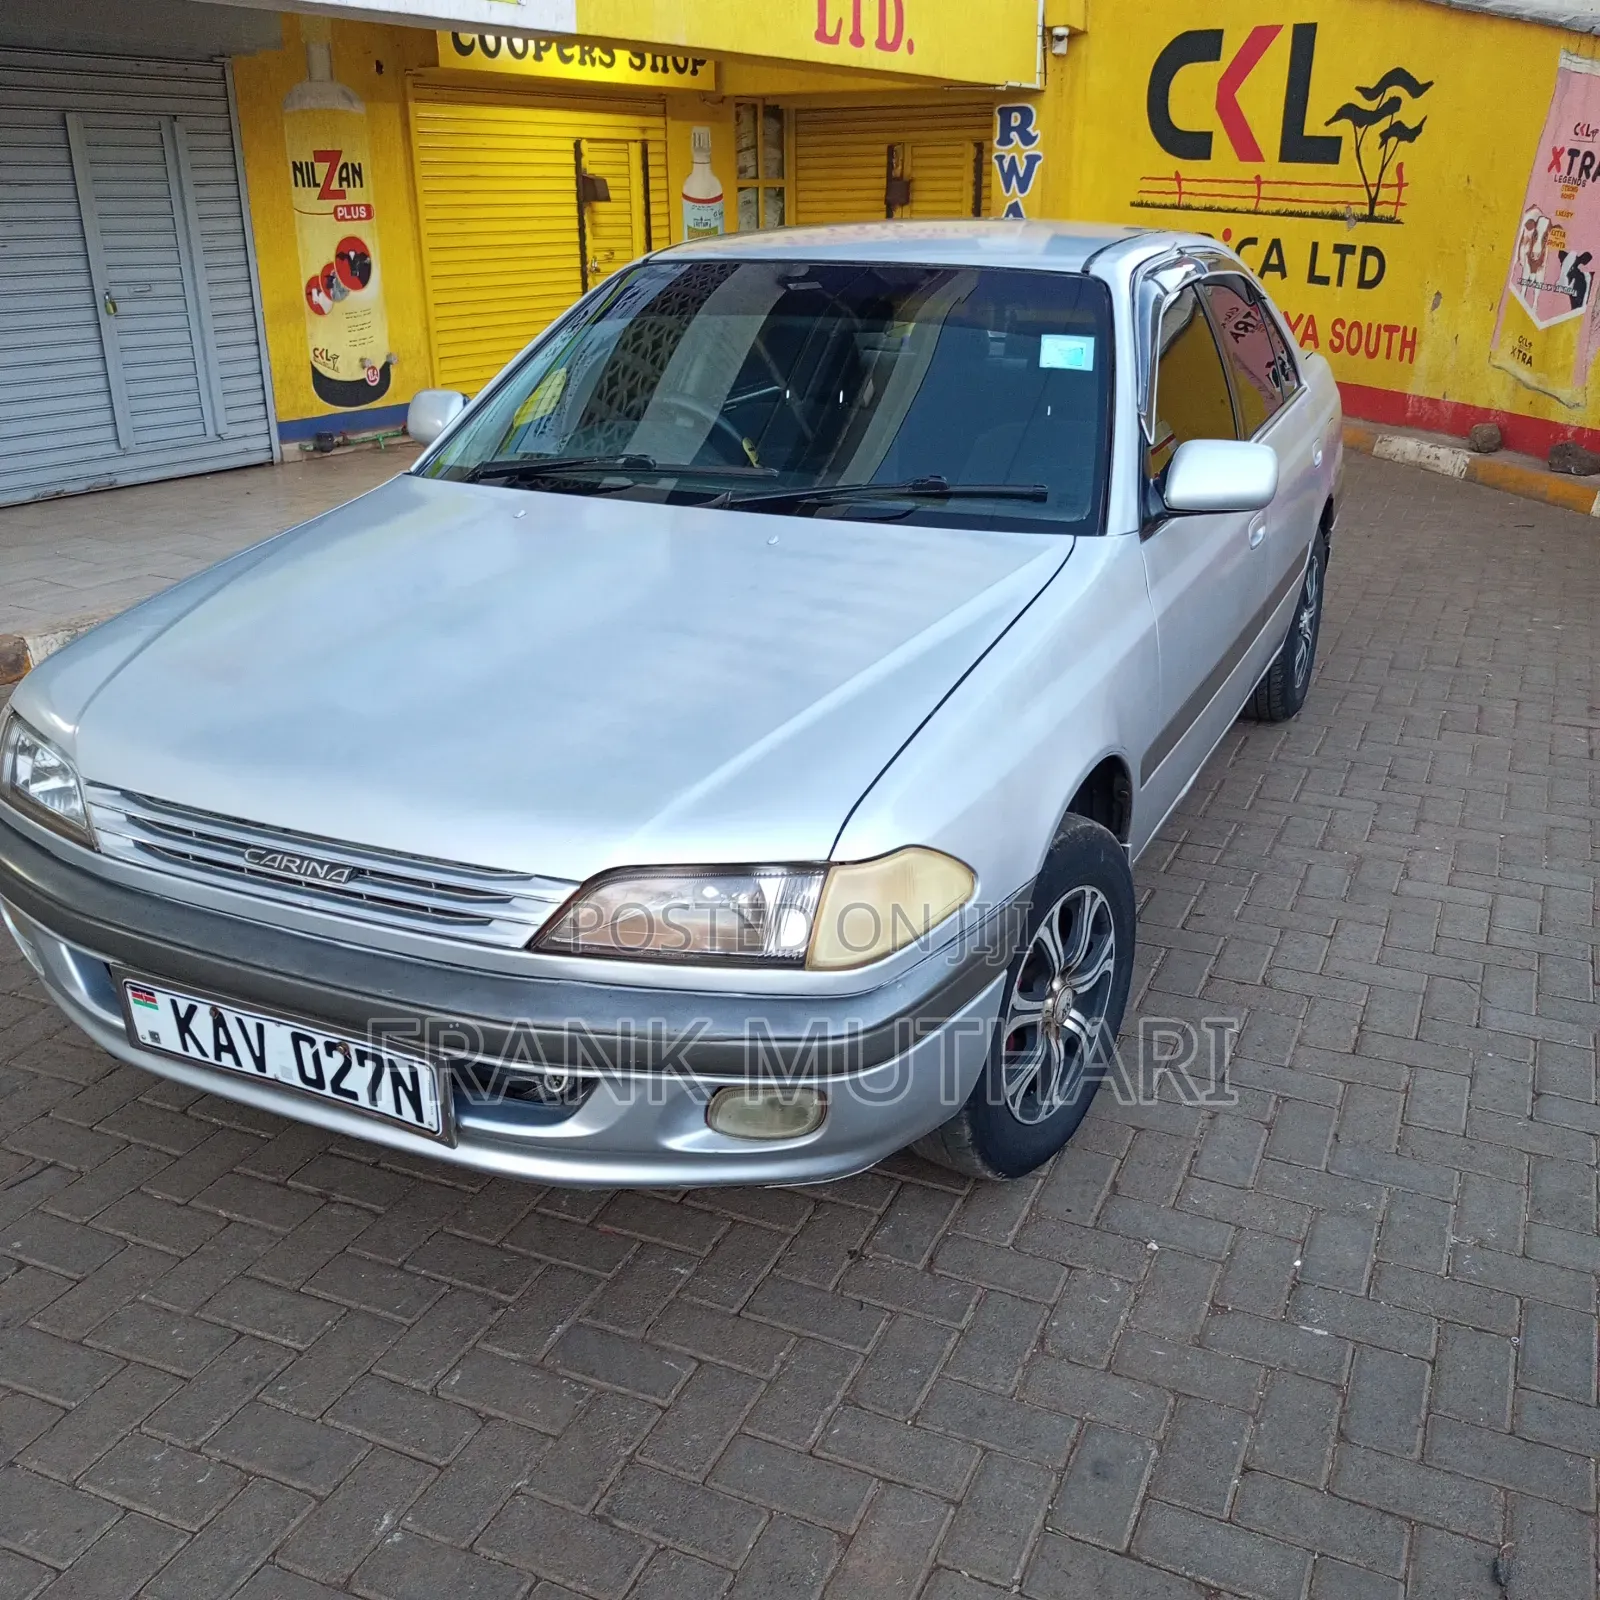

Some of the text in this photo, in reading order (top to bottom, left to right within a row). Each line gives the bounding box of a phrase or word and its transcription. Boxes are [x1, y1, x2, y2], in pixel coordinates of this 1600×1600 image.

[1147, 22, 1342, 165] CKL
[1574, 122, 1592, 137] CKL
[292, 149, 364, 200] NILZAN
[1554, 174, 1587, 188] LEGENDS
[336, 206, 367, 219] PLUS
[1307, 241, 1387, 290] LTD
[312, 347, 331, 361] CKL
[1328, 317, 1418, 365] SOUTH
[1510, 346, 1533, 367] XTRA
[244, 848, 353, 882] CARINA
[170, 999, 267, 1074] KAV
[291, 1031, 425, 1124] 027N
